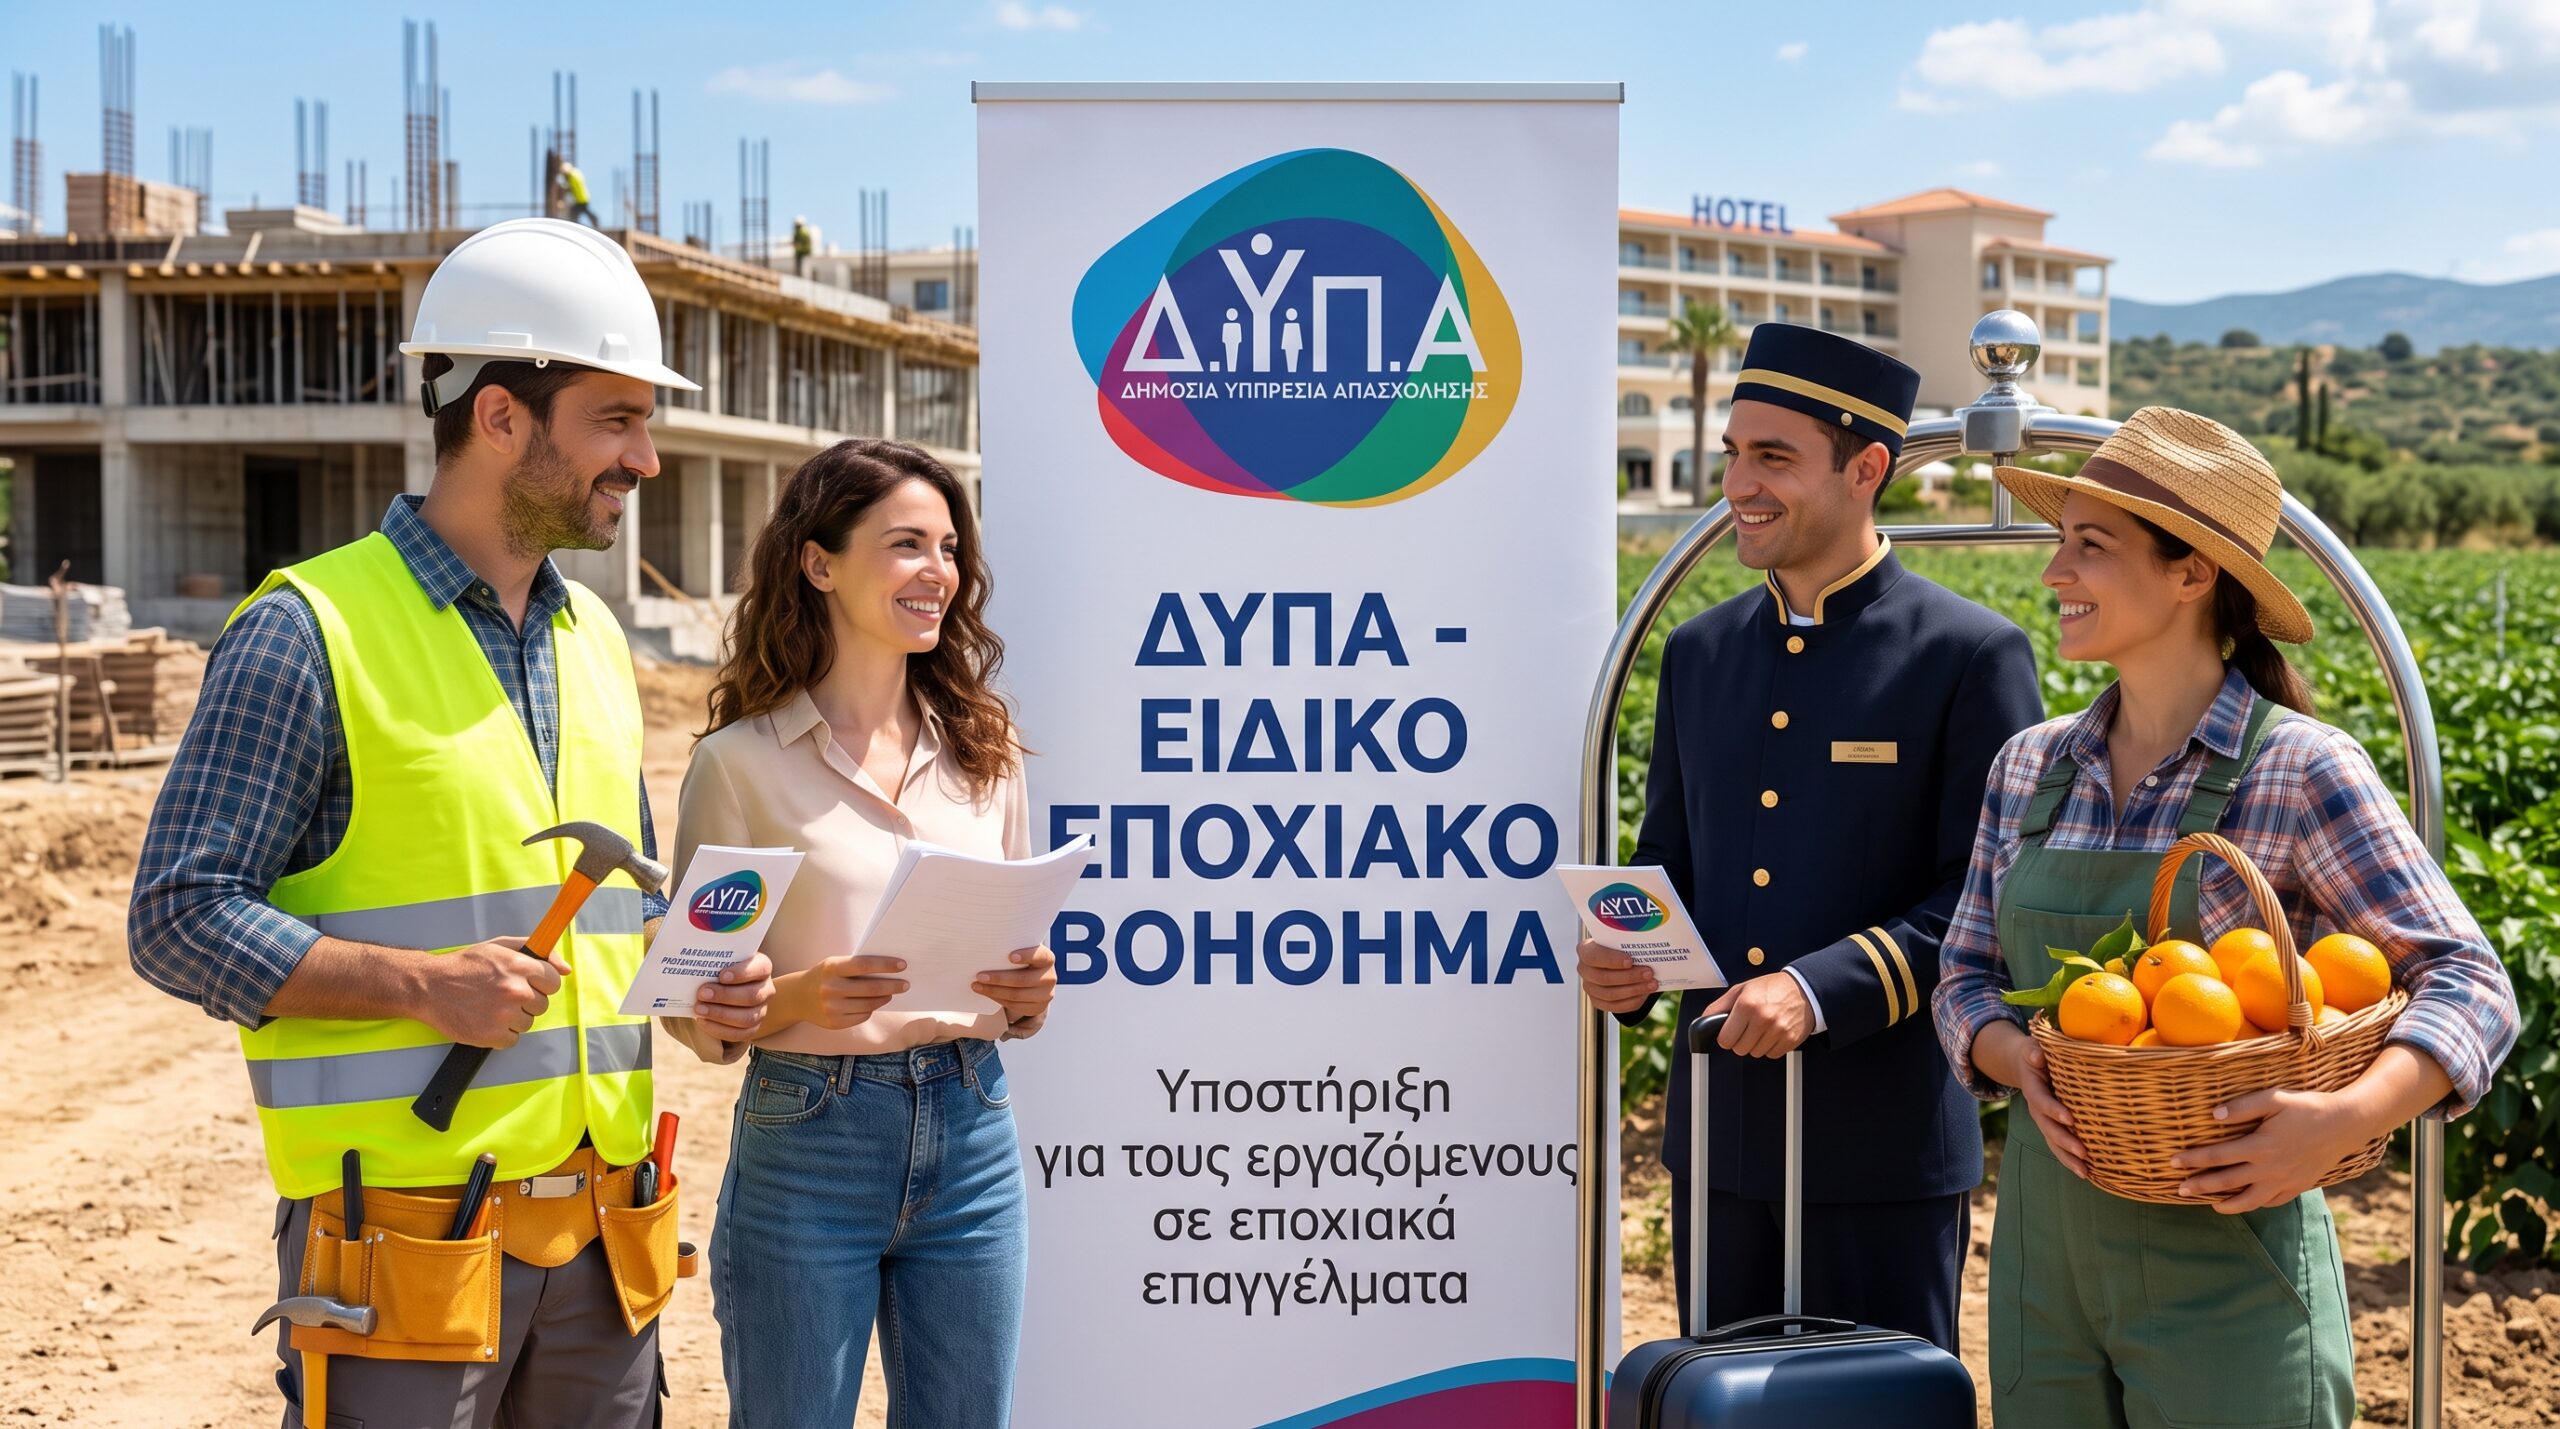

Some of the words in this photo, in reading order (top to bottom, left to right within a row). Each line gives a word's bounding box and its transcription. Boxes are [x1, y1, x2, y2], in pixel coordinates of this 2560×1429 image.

[1692, 193, 1794, 234] HOTEL
[1121, 382, 1218, 399] ΔΗΜΟΣΙΑ
[1333, 382, 1488, 399] ΑΠΑΣΧΟΛΗΣΗΣ
[1135, 592, 1409, 666] ΔΥΠΑ
[1141, 697, 1468, 773] ΕΙΔΙΚΟ
[1050, 803, 1559, 879] ΕΠΟΧΙΑΚΟ
[698, 887, 759, 911] ΔΥΠΑ
[1050, 910, 1564, 985] ΒΟΗΘΗΜΑ
[1157, 1065, 1450, 1123] Υποστήριξη
[1035, 1143, 1104, 1188] για
[1122, 1143, 1230, 1188] τους
[1247, 1131, 1577, 1188] εργαζόμενους
[1153, 1207, 1211, 1240] σε
[1230, 1194, 1455, 1241] εποχιακά
[1142, 1258, 1468, 1316] επαγγέλματα
